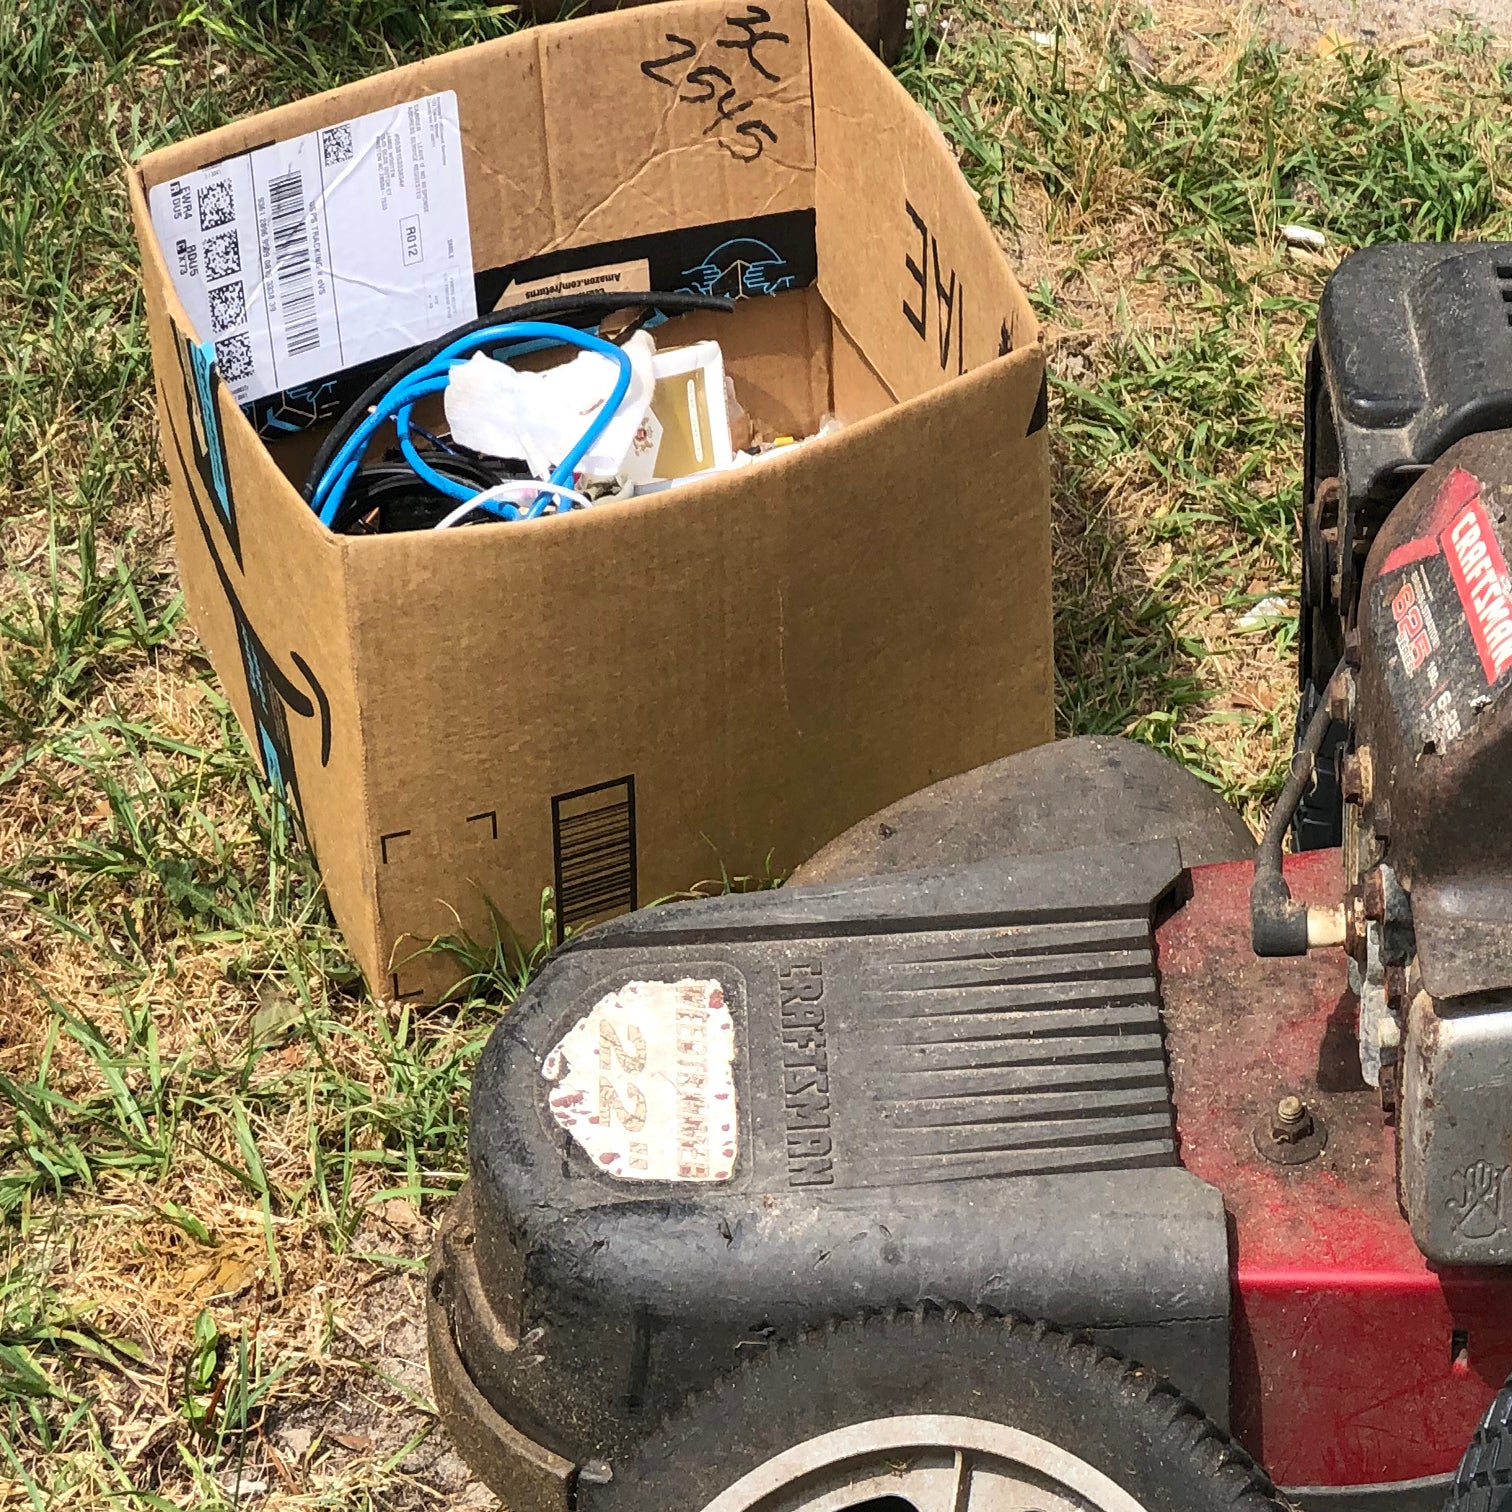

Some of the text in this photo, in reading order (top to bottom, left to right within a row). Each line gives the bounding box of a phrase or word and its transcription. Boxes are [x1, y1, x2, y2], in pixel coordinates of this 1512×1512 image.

[525, 272, 622, 299] Amazon.com/returns
[1391, 583, 1432, 670] 625
[778, 960, 835, 1188] CRAFTSMAN
